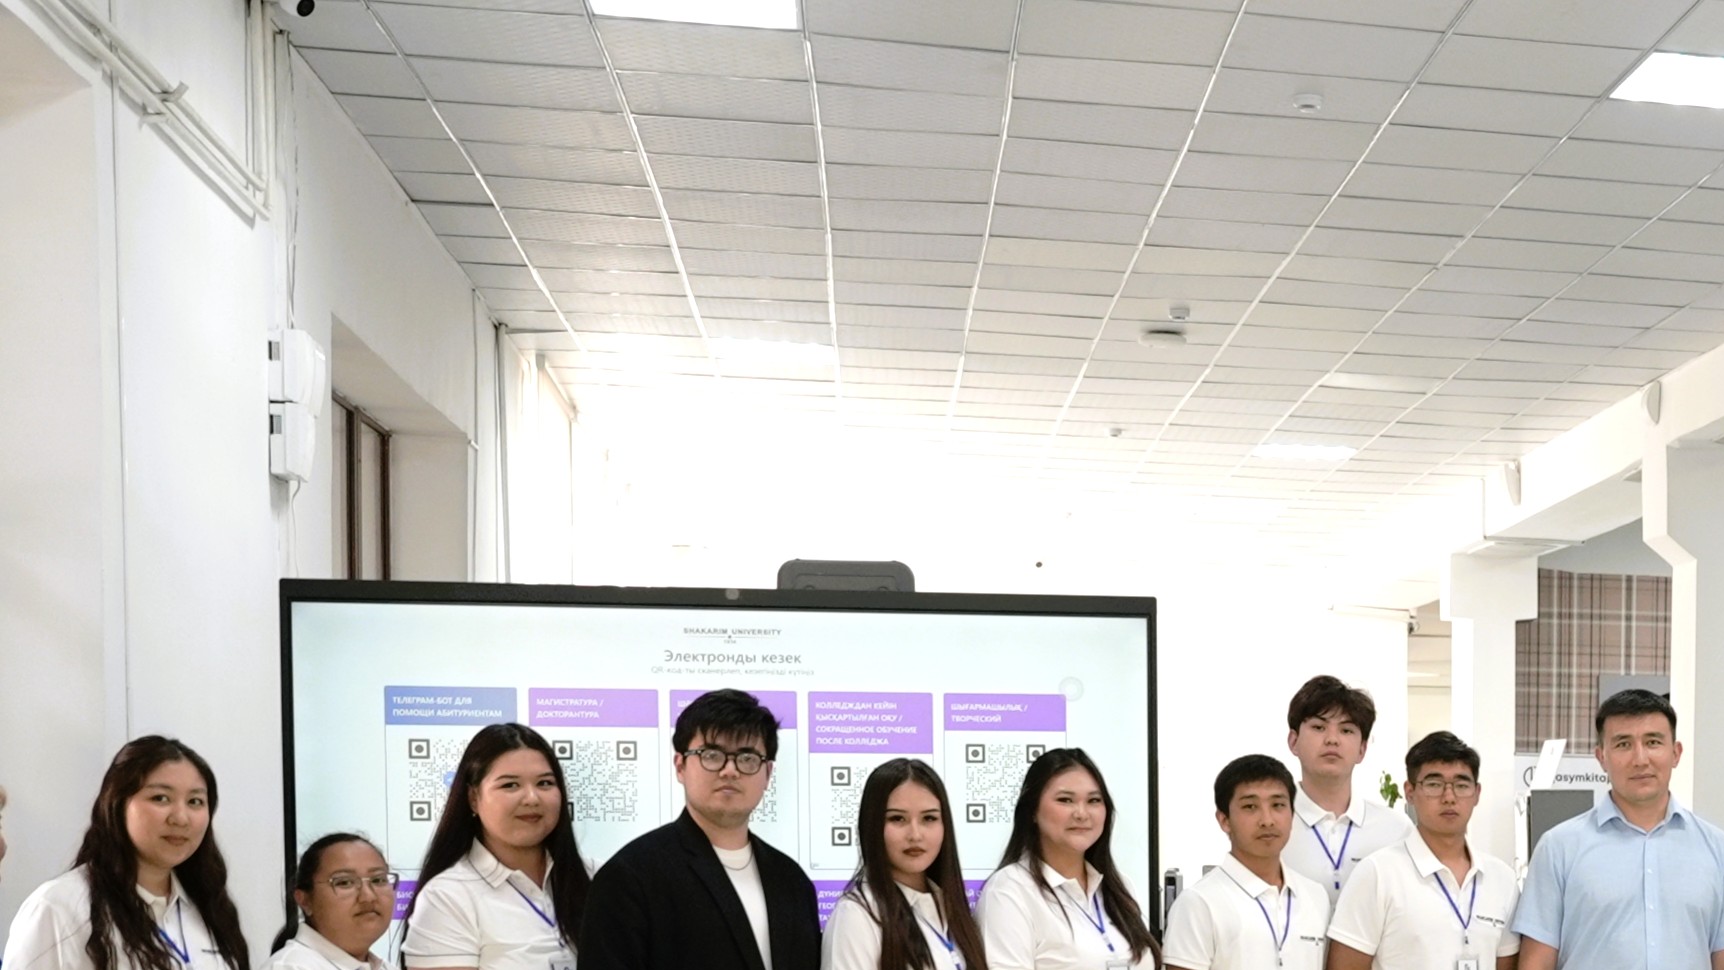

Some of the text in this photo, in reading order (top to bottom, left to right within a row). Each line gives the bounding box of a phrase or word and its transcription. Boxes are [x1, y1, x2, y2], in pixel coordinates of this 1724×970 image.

[683, 627, 782, 636] SHAKARIM UNIVERSITY
[664, 650, 802, 665] Электронды кезек
[392, 696, 473, 706] ТЕЛЕГРАМ-БОТ ДЛЯ
[536, 698, 598, 707] МАГИСТРАТУРА
[815, 702, 872, 711] КОЛЛЕДЖДАН
[392, 708, 502, 719] ПОМОЩИ АБИТУРИЕНТАМ
[536, 710, 600, 720] ДОКТОРАНТУРА
[951, 714, 1003, 724] ТВОРЧЕСКИЙ
[815, 726, 918, 735] СОКРАЩЕННОЕ ОБУЧЕНИЕ
[815, 737, 890, 747] ПОСЛЕ КОЛЛЕДЖА
